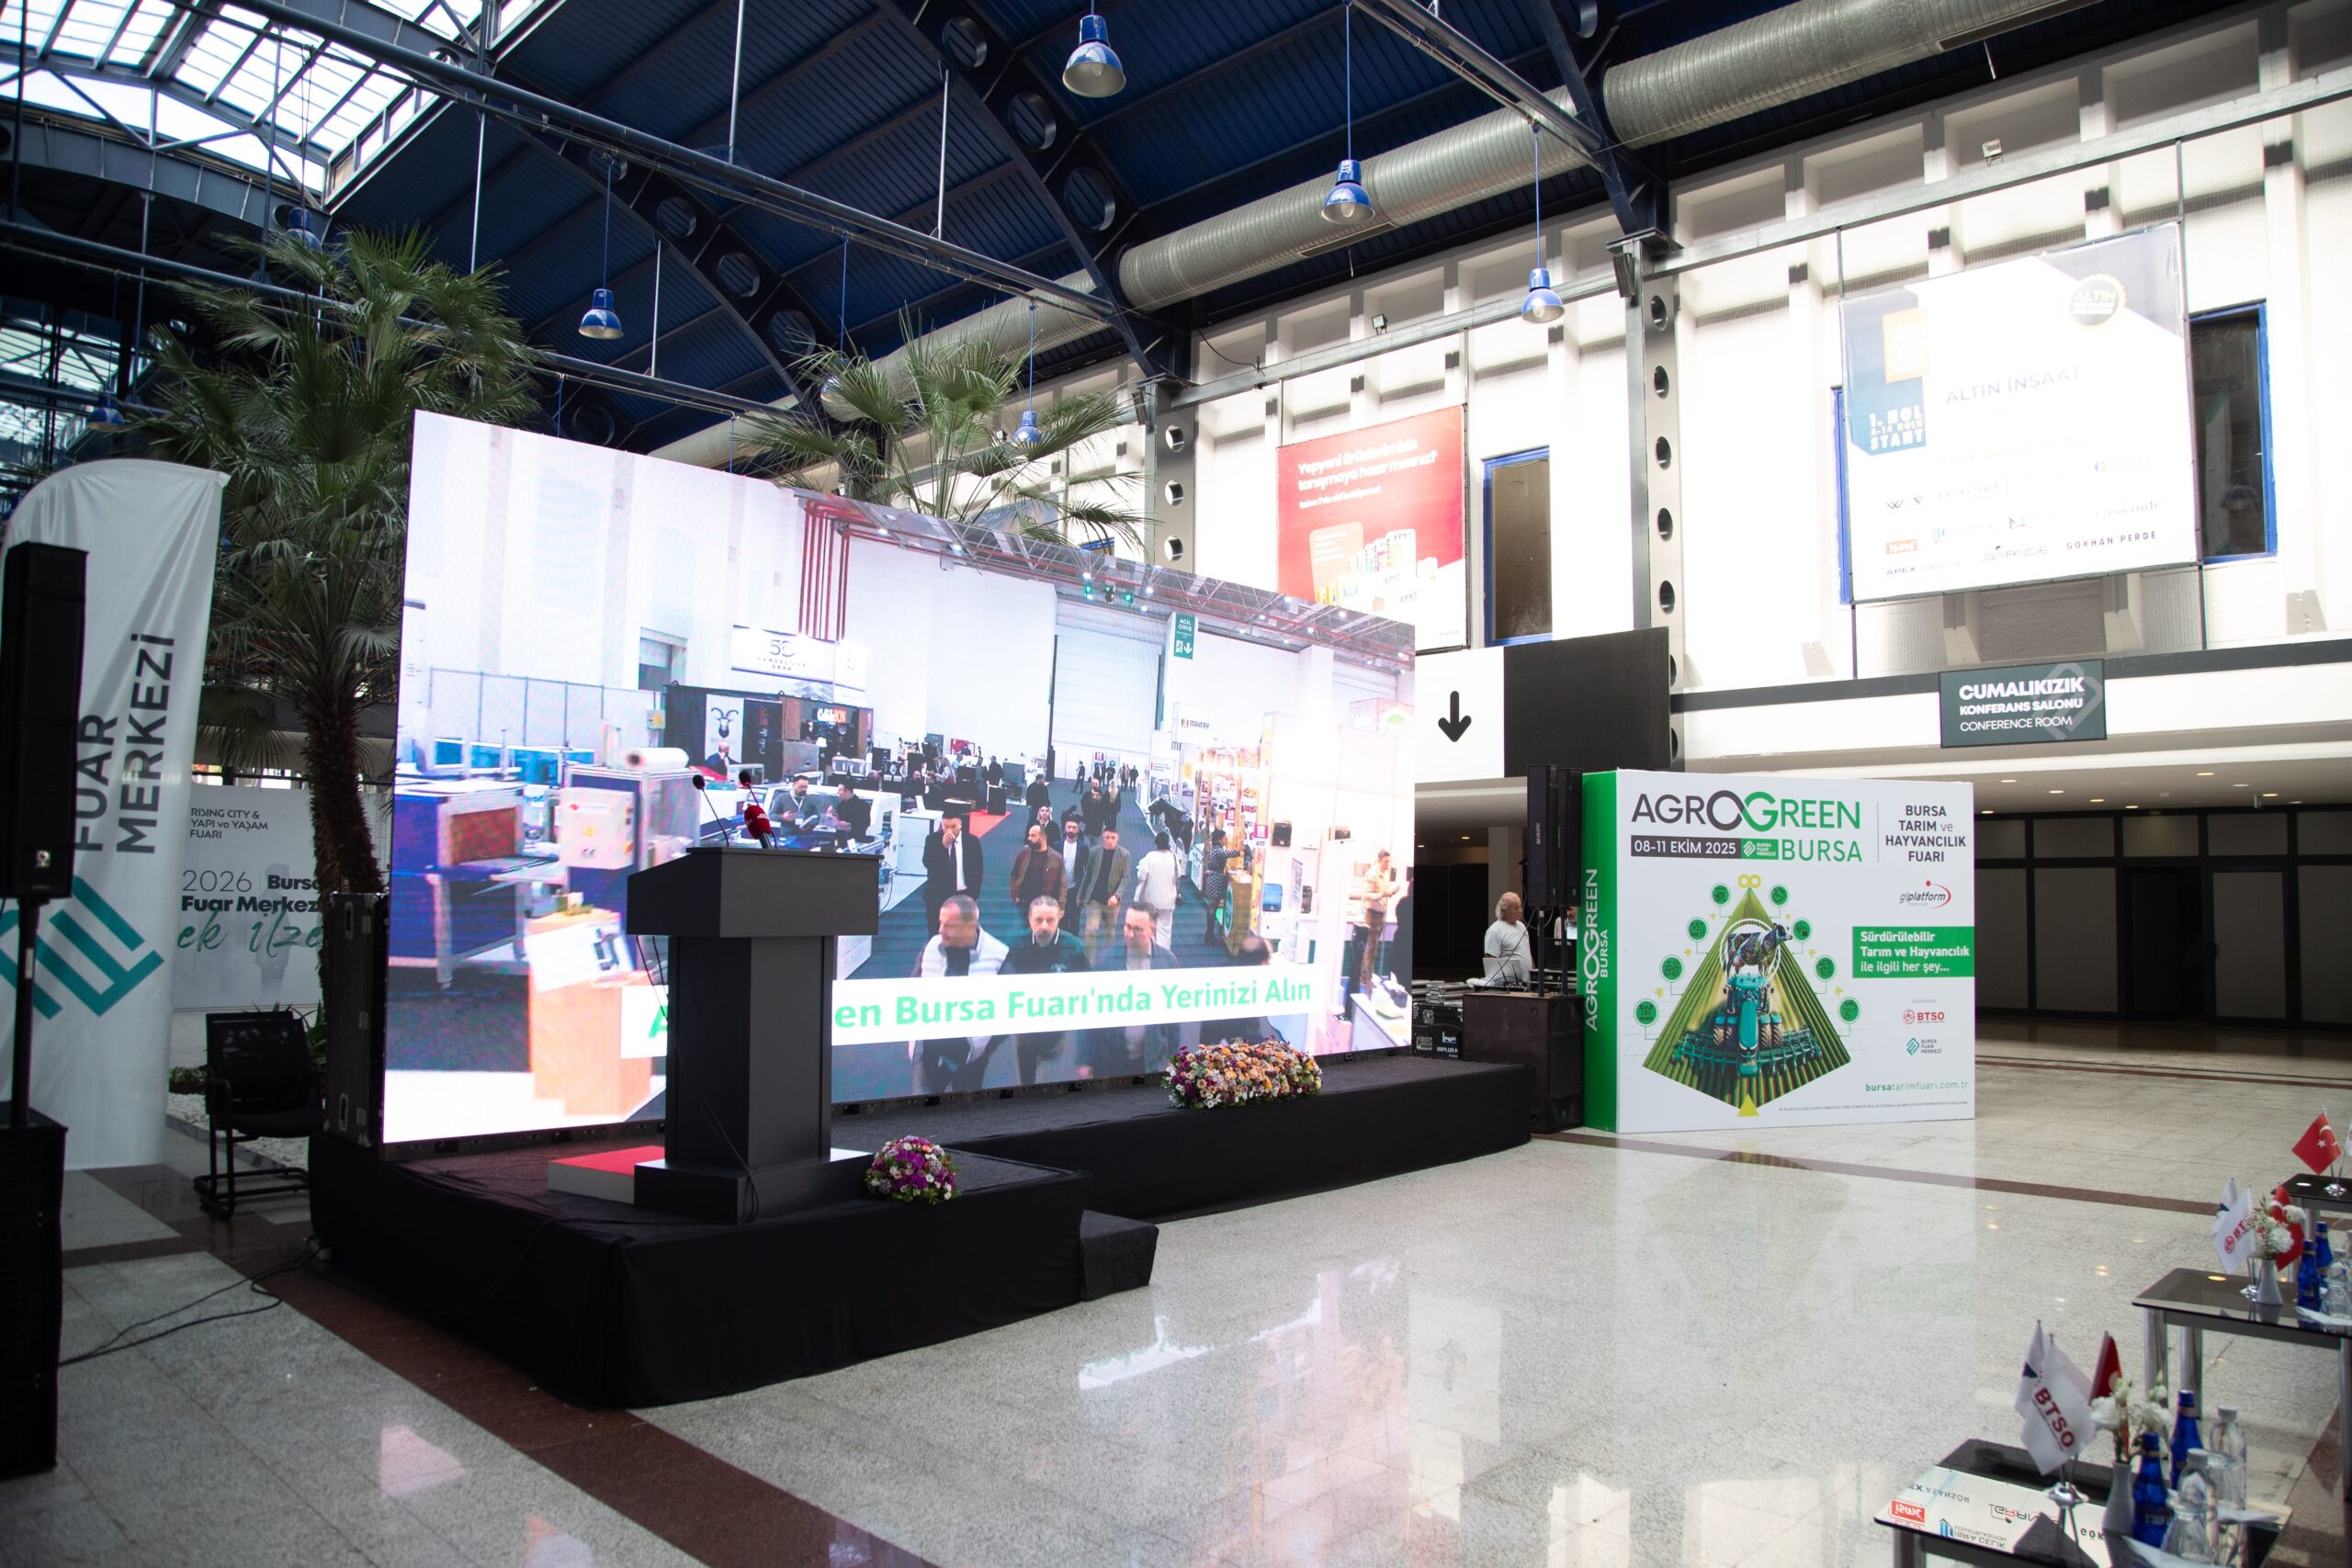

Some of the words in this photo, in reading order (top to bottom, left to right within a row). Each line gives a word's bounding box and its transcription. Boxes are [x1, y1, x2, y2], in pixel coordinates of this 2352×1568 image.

[1945, 382, 2000, 404] ALTIN
[1870, 428, 1925, 451] STANT
[1297, 454, 1342, 476] Yepyeni
[2120, 531, 2157, 543] PERDE
[1959, 676, 2086, 701] CUMALIKIZIK
[1960, 700, 2030, 716] KONFERANS
[2031, 698, 2084, 712] SALONU
[1960, 717, 2033, 732] CONFERENCE
[2035, 716, 2073, 728] ROOM
[116, 634, 175, 854] MERKEZİ
[191, 807, 225, 818] RISING
[227, 809, 251, 819] CITY
[253, 810, 260, 819] &
[1631, 790, 1860, 832] AGROGREEN
[1905, 805, 1947, 817] BURSA
[191, 818, 215, 829] YAPI
[217, 820, 230, 829] ve
[232, 820, 268, 832] YAŞAM
[1898, 819, 1937, 832] TARIM
[1939, 823, 1953, 832] ve
[190, 829, 222, 839] FUARI
[1885, 834, 1966, 847] HAYVANCILIK
[1634, 840, 1667, 853] 08-11
[1670, 839, 1702, 854] EKİM
[1705, 841, 1736, 855] 2025
[1781, 839, 1863, 863] BURSA
[1908, 851, 1945, 863] FUARI
[182, 870, 253, 893] 2026
[181, 896, 234, 912] Fuar
[236, 897, 320, 915] Merkez
[176, 909, 229, 953] ek
[1860, 931, 1936, 942] Sürdürülebilir
[1583, 868, 1600, 1032] AGROGREEN
[1600, 929, 1609, 978] BURSA
[1860, 946, 1892, 957] Tarım
[1894, 949, 1907, 957] ve
[1909, 946, 1971, 959] Hayvancılık
[1860, 962, 1873, 972] ile
[1876, 961, 1900, 974] ilgili
[1902, 962, 1920, 972] her
[1922, 963, 1950, 974] şey...
[835, 1005, 881, 1028] en
[896, 995, 996, 1025] Bursa
[1008, 985, 1151, 1019] Fuarı'nda
[1161, 980, 1257, 1010] Yerinizi
[1264, 977, 1311, 1003] Alın
[1917, 1011, 1945, 1021] BTSO
[1865, 1081, 1969, 1092] bursatarimfuari.com.tr
[2033, 1386, 2075, 1449] BTSO
